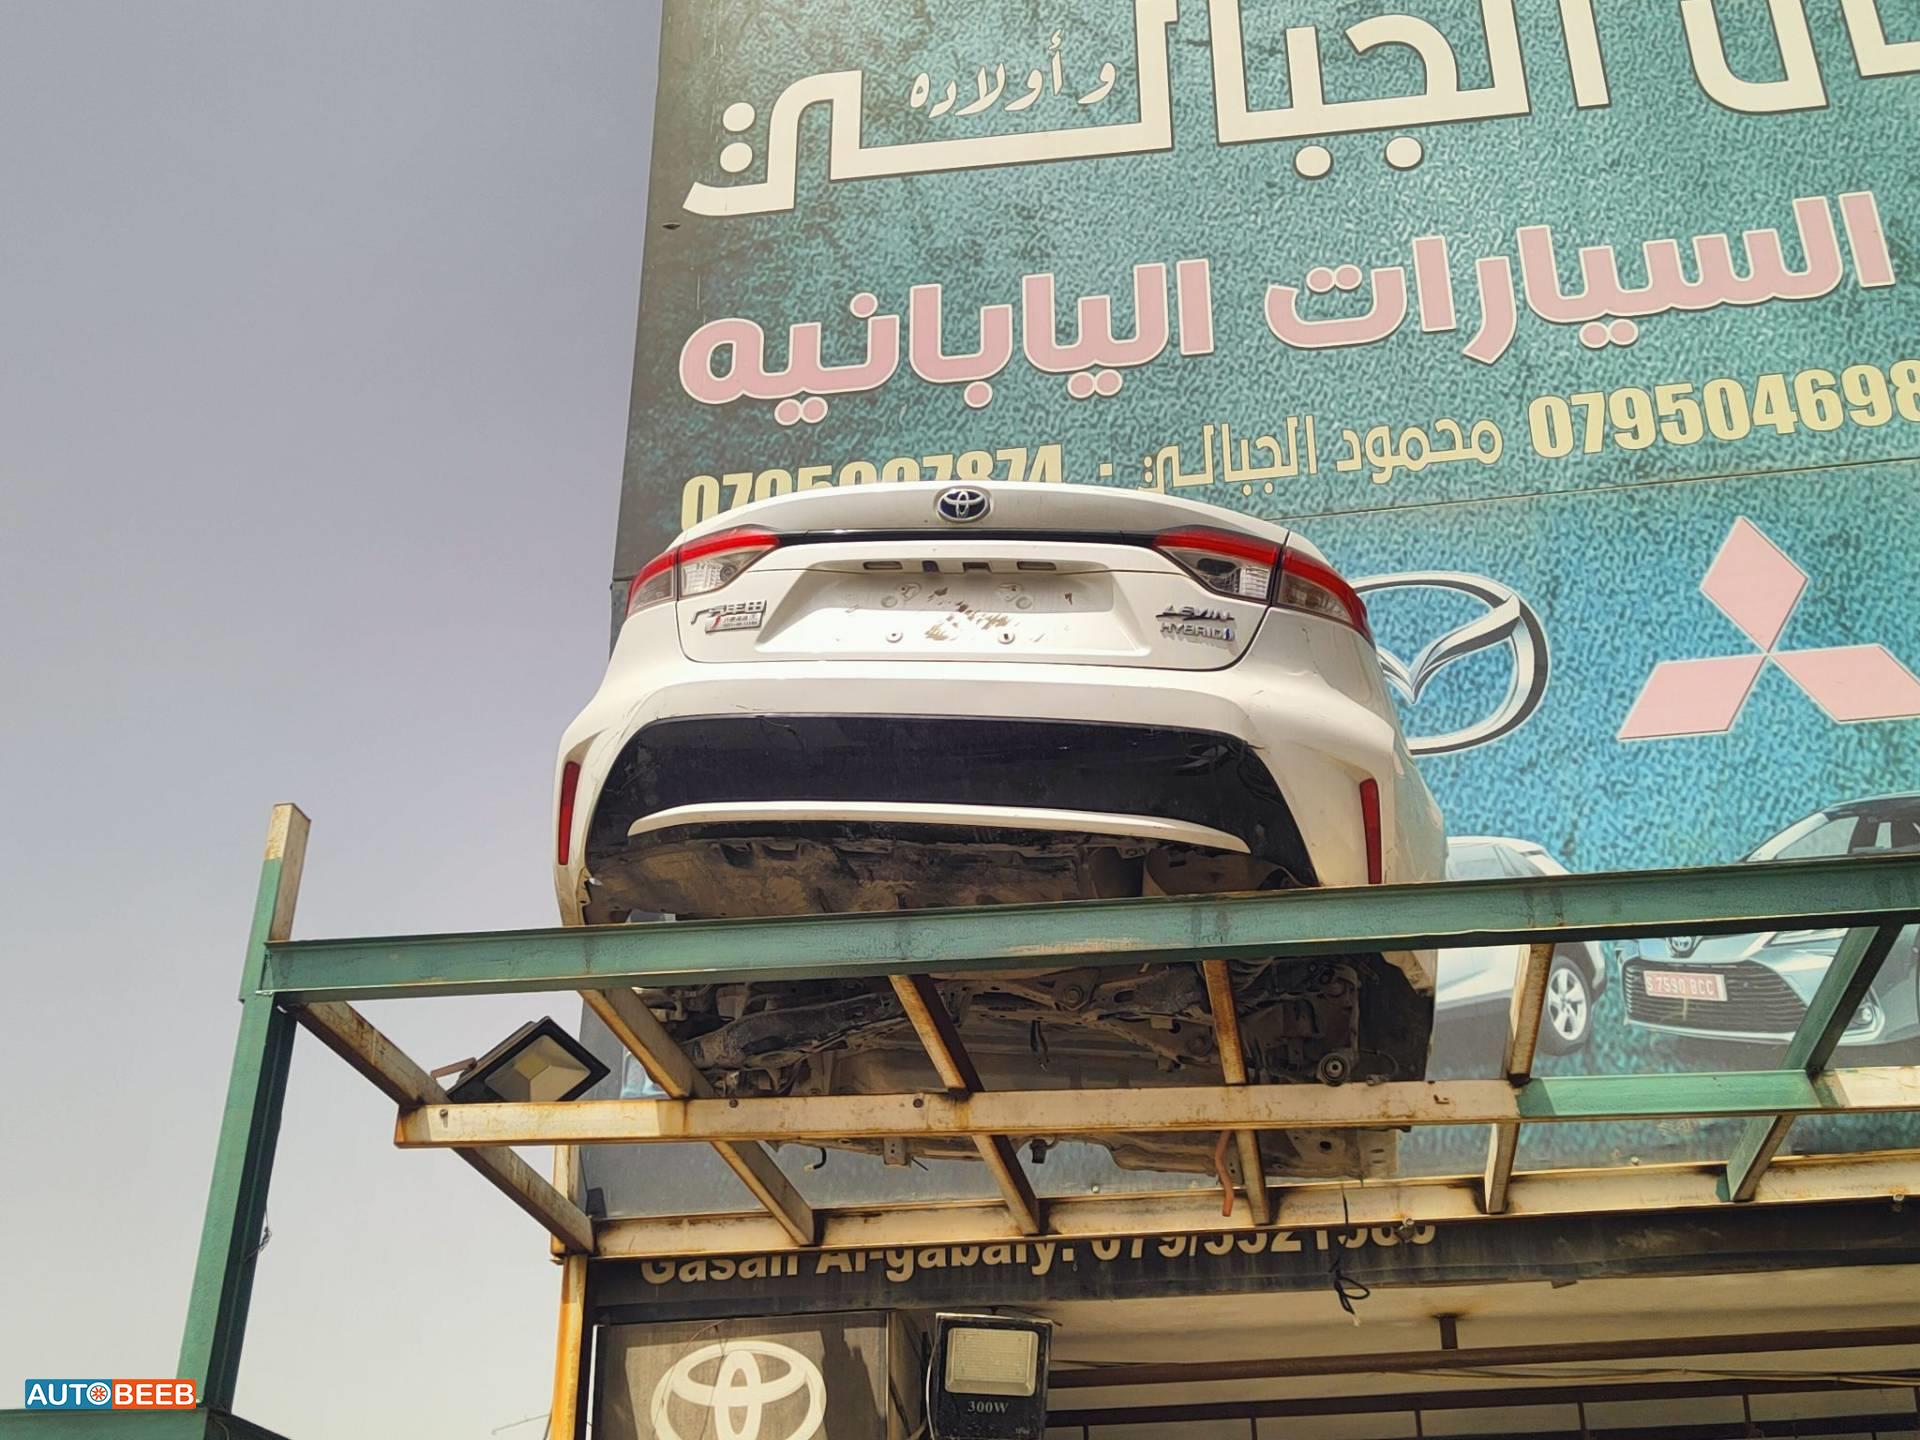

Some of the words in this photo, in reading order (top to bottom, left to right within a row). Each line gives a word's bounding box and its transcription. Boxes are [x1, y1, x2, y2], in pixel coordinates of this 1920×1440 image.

[682, 0, 1611, 217] الجبالي
[1264, 190, 1896, 365] السيارات
[679, 257, 1215, 427] اليابانيه
[1136, 414, 1319, 497] الجبالي
[1336, 416, 1504, 486] محمود
[967, 1400, 1009, 1414] 300W
